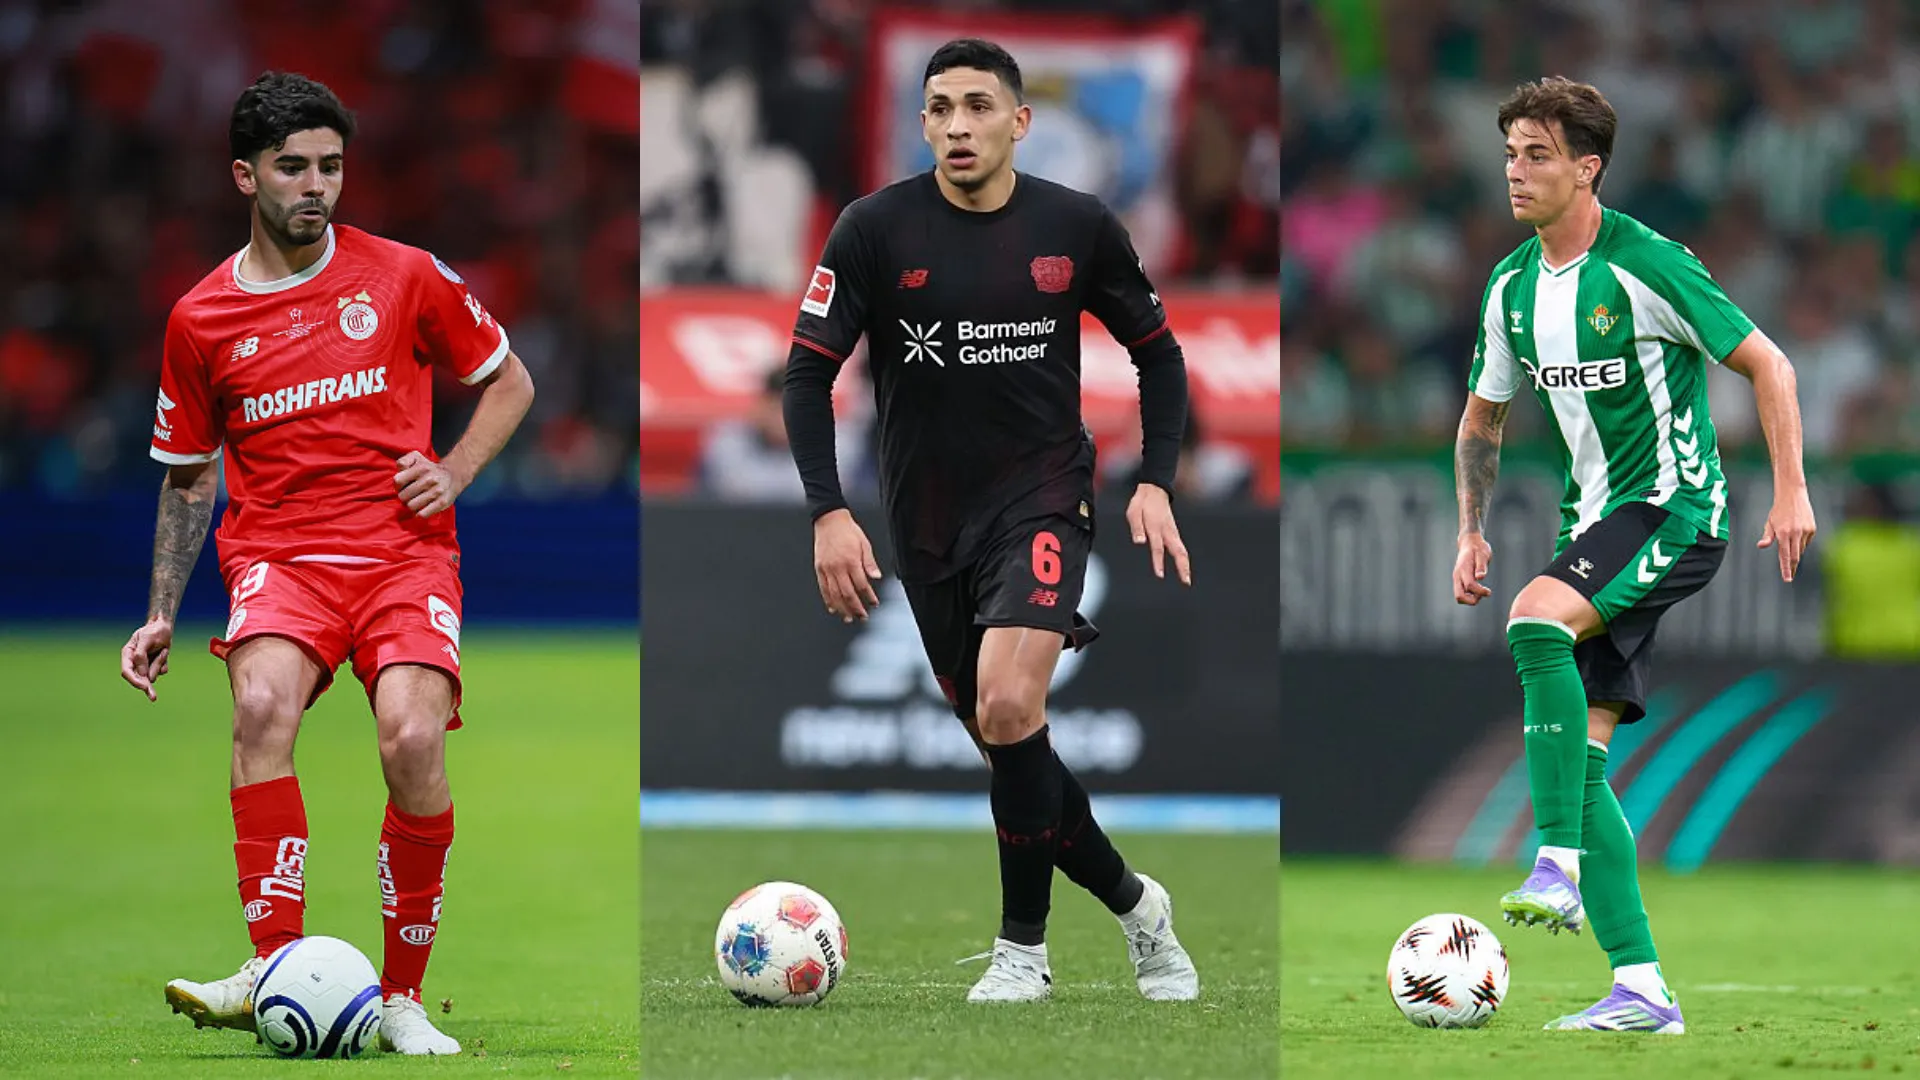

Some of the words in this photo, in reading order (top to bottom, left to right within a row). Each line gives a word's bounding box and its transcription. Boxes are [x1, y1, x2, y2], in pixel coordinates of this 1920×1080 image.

[957, 316, 1057, 341] Barmenia
[958, 342, 1048, 365] Gothaer
[1032, 531, 1062, 585] 6
